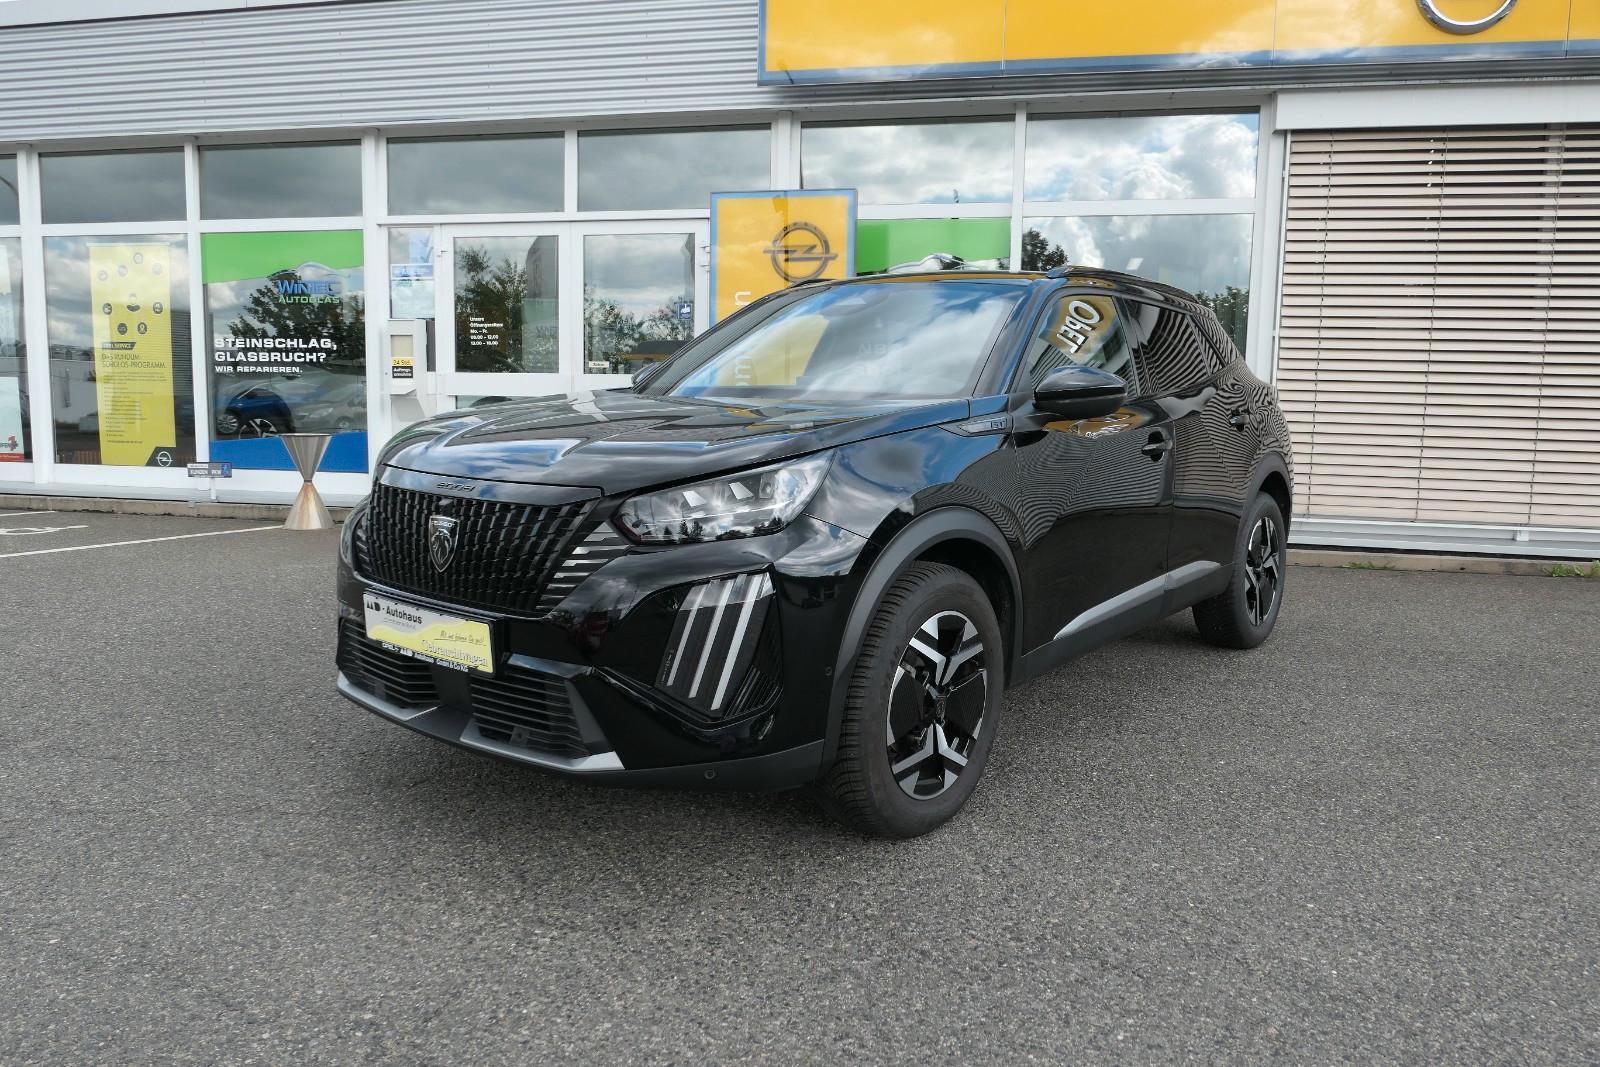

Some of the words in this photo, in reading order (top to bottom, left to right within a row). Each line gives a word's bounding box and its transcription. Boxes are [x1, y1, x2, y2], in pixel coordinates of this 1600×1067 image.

[278, 296, 340, 304] AUTOGLAS
[214, 338, 337, 350] STEINSCHLAG,
[214, 351, 327, 363] GLASBRUCH?
[214, 365, 234, 373] WIR
[236, 366, 303, 374] REPARIEREN.
[386, 606, 423, 624] Autohaus
